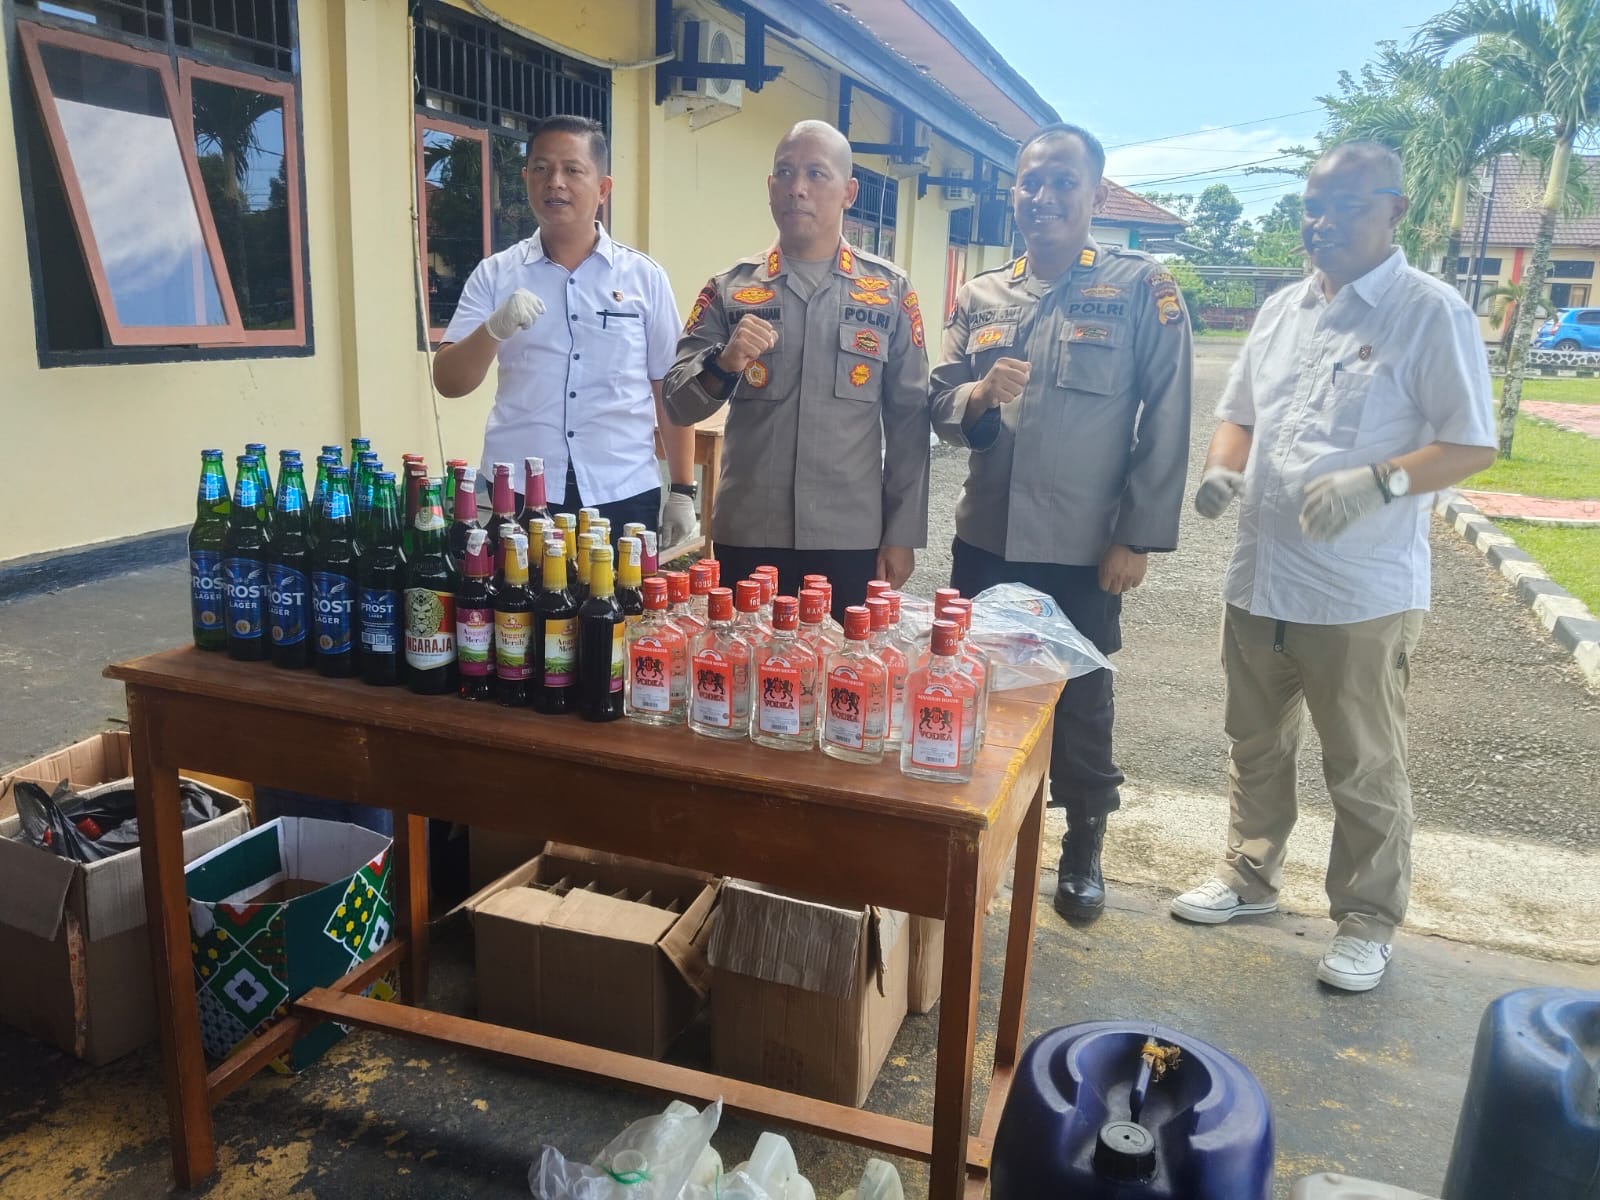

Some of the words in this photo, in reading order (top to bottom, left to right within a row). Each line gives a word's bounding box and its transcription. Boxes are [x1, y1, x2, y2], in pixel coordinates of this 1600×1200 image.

[1069, 302, 1125, 316] POLRI
[845, 307, 890, 330] POLRI
[229, 601, 258, 609] LAGER
[361, 602, 394, 613] PROST
[764, 699, 794, 710] VODKA
[919, 729, 953, 742] VODKA
